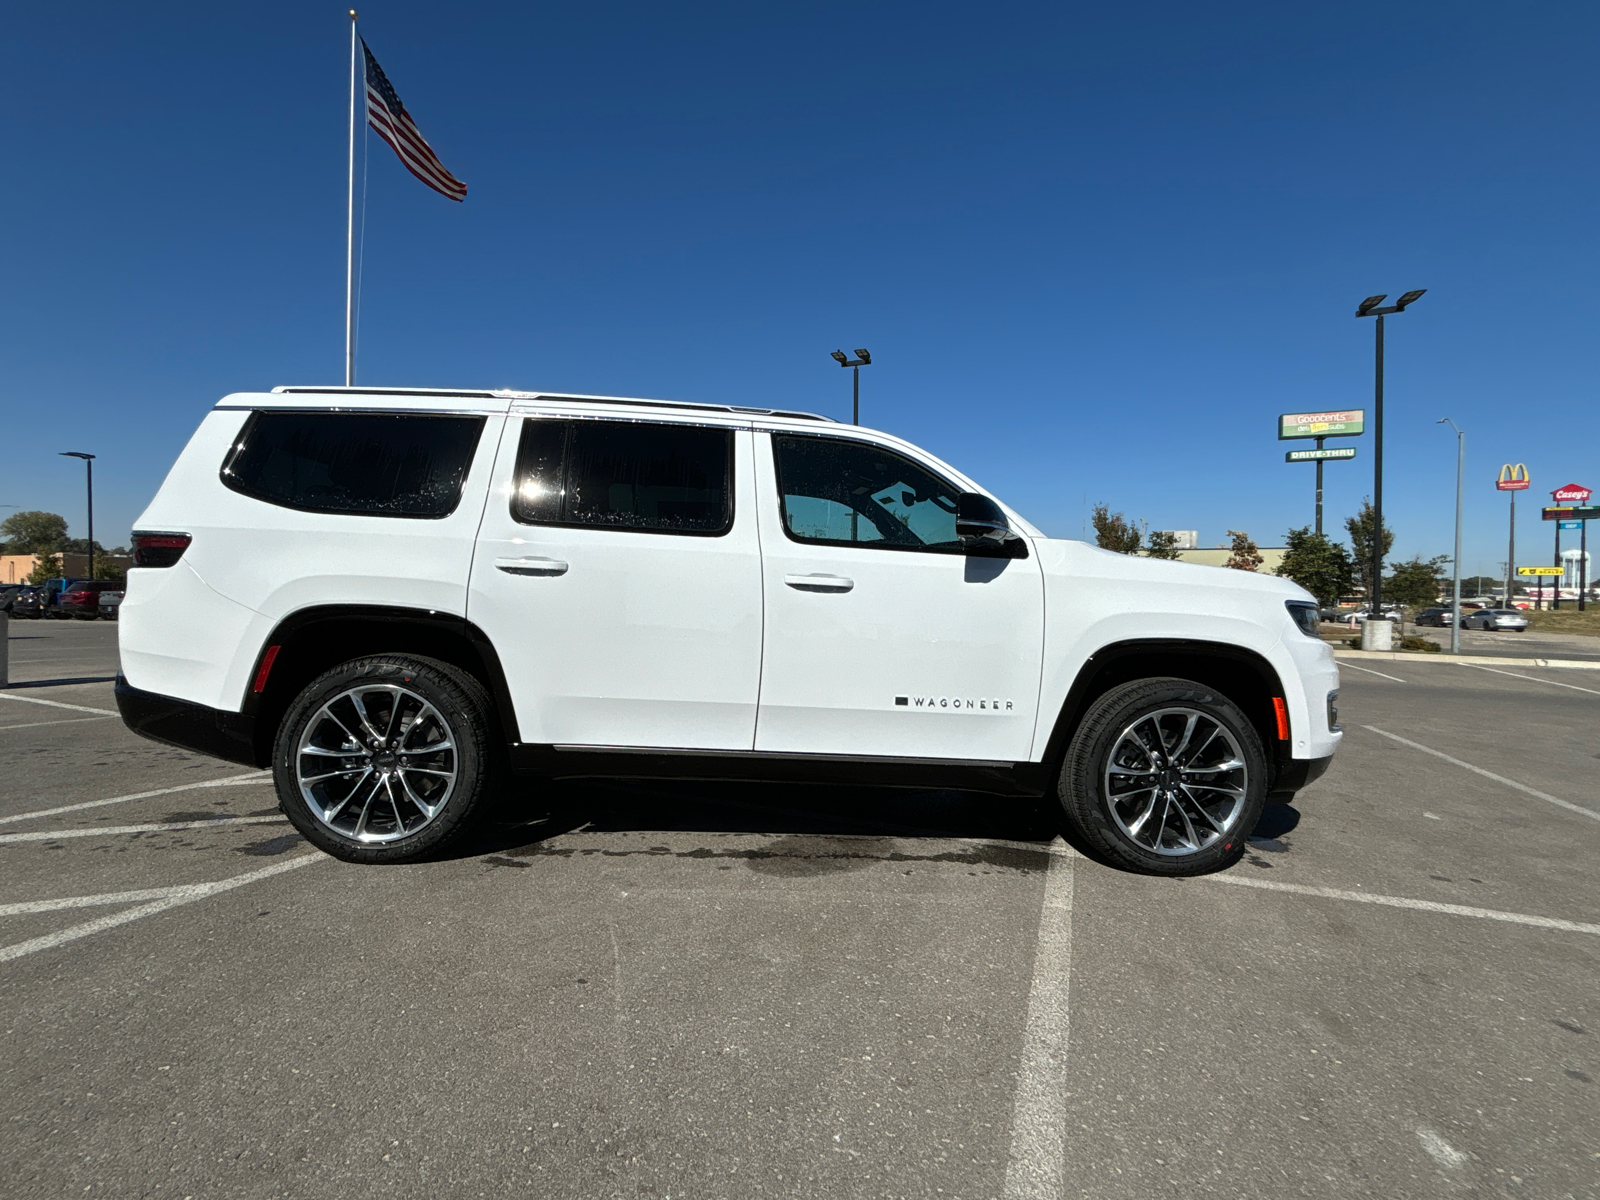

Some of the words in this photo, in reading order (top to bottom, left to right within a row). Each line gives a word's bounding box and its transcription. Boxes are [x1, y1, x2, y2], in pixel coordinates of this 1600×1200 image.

[1291, 449, 1354, 459] DRIVE-THRU
[1556, 490, 1589, 499] Casey's
[914, 697, 1013, 710] WAGONEER
